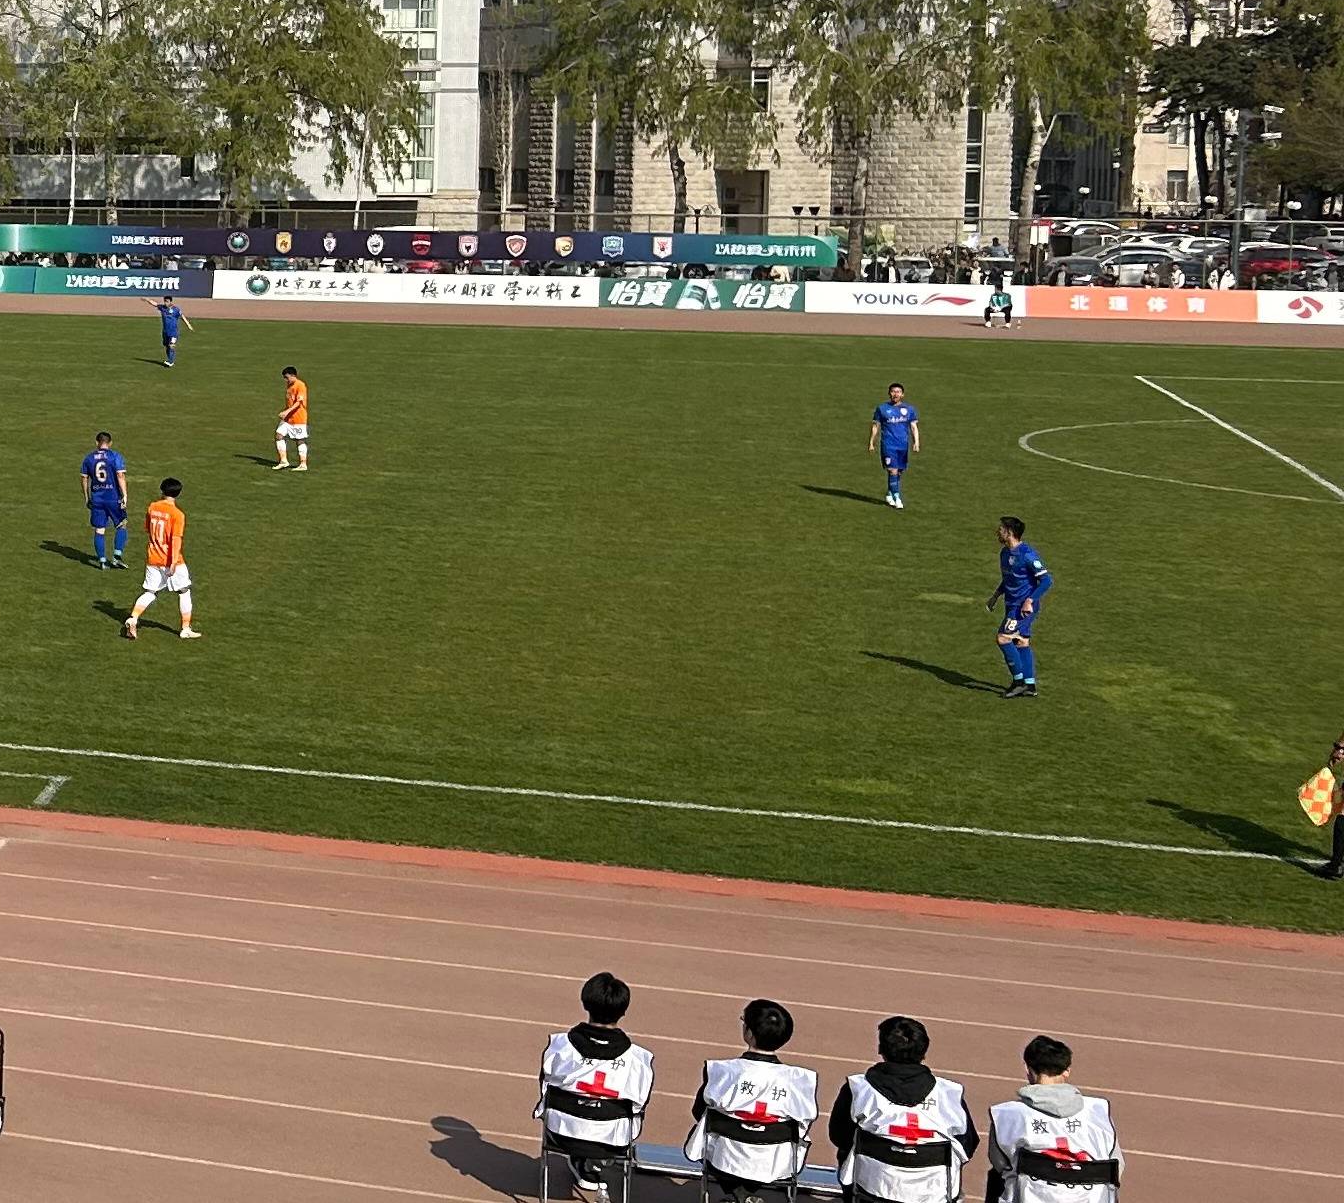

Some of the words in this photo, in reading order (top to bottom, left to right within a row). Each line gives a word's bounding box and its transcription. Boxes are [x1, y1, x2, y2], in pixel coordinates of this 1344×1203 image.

[853, 293, 918, 306] YOUNG
[1069, 295, 1206, 314] 北理体育
[95, 461, 108, 483] 6
[740, 1080, 787, 1101] 救护
[1031, 1118, 1082, 1135] 救护
